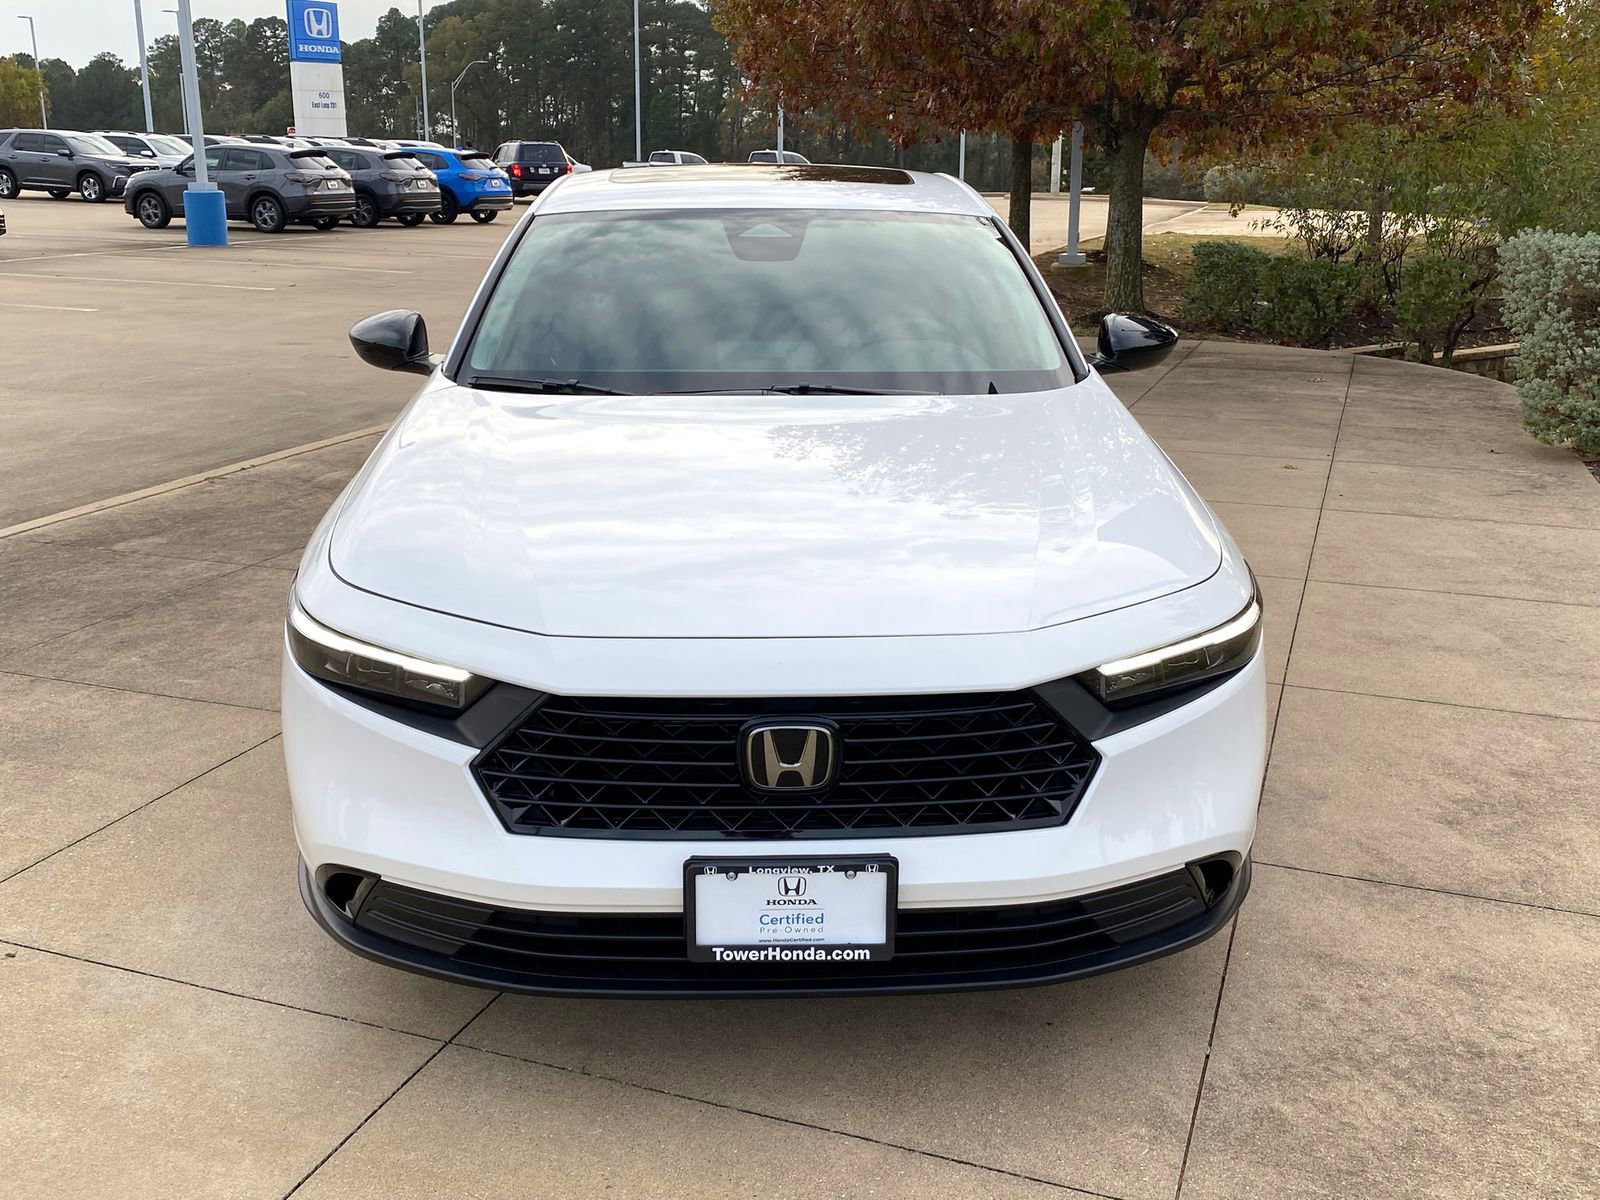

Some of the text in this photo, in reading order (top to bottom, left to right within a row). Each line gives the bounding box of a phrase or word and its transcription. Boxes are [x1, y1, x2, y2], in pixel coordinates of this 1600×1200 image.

[298, 44, 340, 54] HONDA
[318, 91, 330, 99] 600
[311, 101, 321, 109] East
[817, 865, 835, 873] TX
[759, 913, 824, 925] Certified
[712, 947, 871, 961] TowerHonda.com
